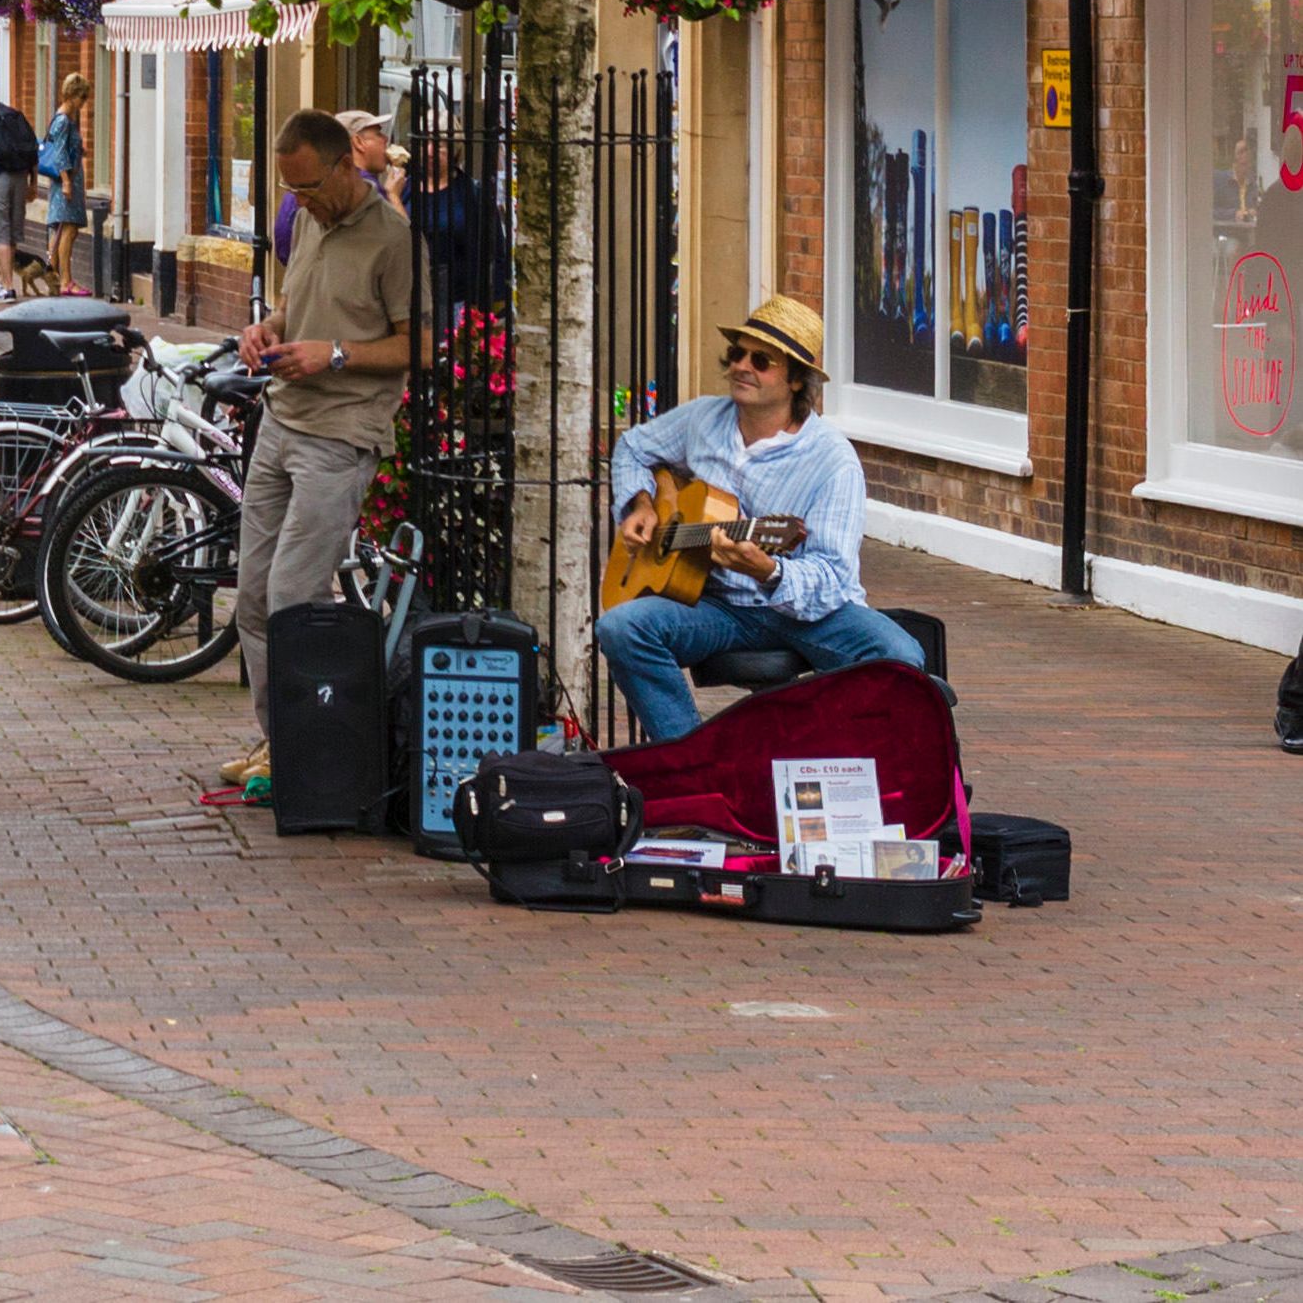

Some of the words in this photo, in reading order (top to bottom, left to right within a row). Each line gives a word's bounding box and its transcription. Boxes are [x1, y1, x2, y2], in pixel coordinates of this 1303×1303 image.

[1233, 357, 1282, 406] SEASIDE
[823, 765, 839, 774] £10
[841, 765, 863, 773] each
